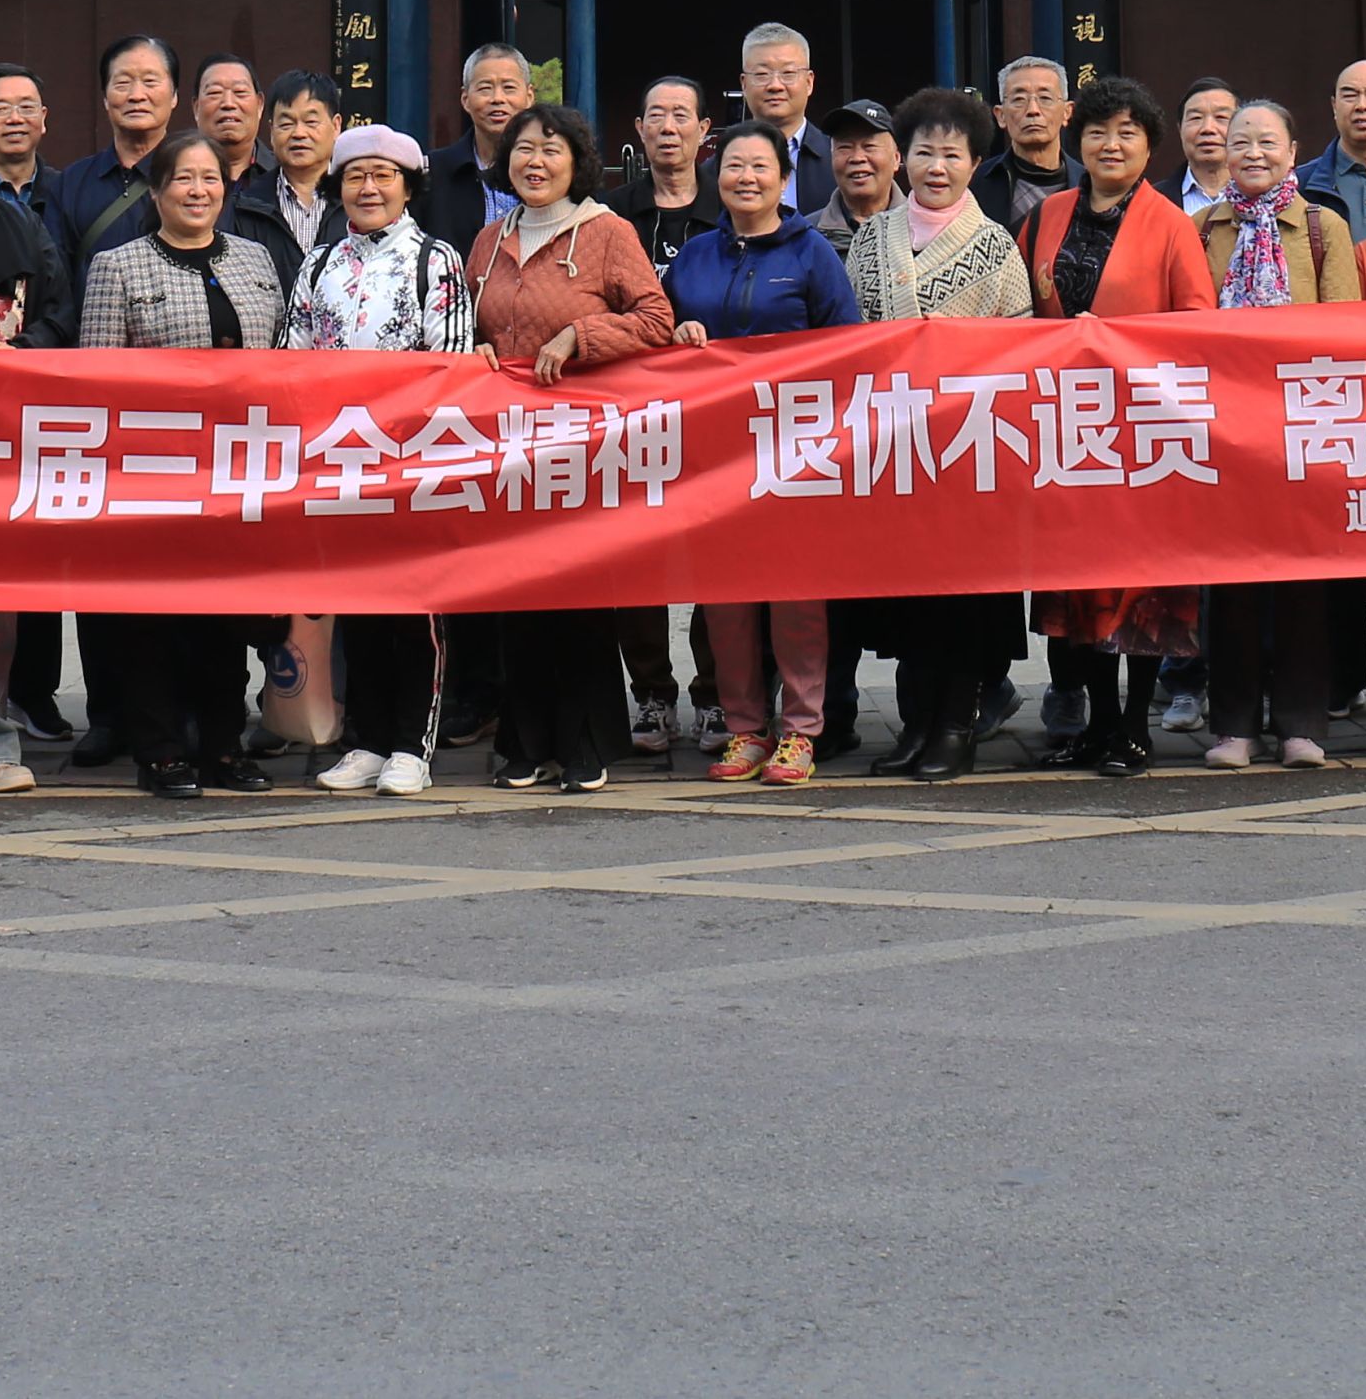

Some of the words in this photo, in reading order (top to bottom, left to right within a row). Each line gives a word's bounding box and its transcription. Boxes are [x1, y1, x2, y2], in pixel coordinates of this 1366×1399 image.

[747, 361, 1219, 500] 退休不退责
